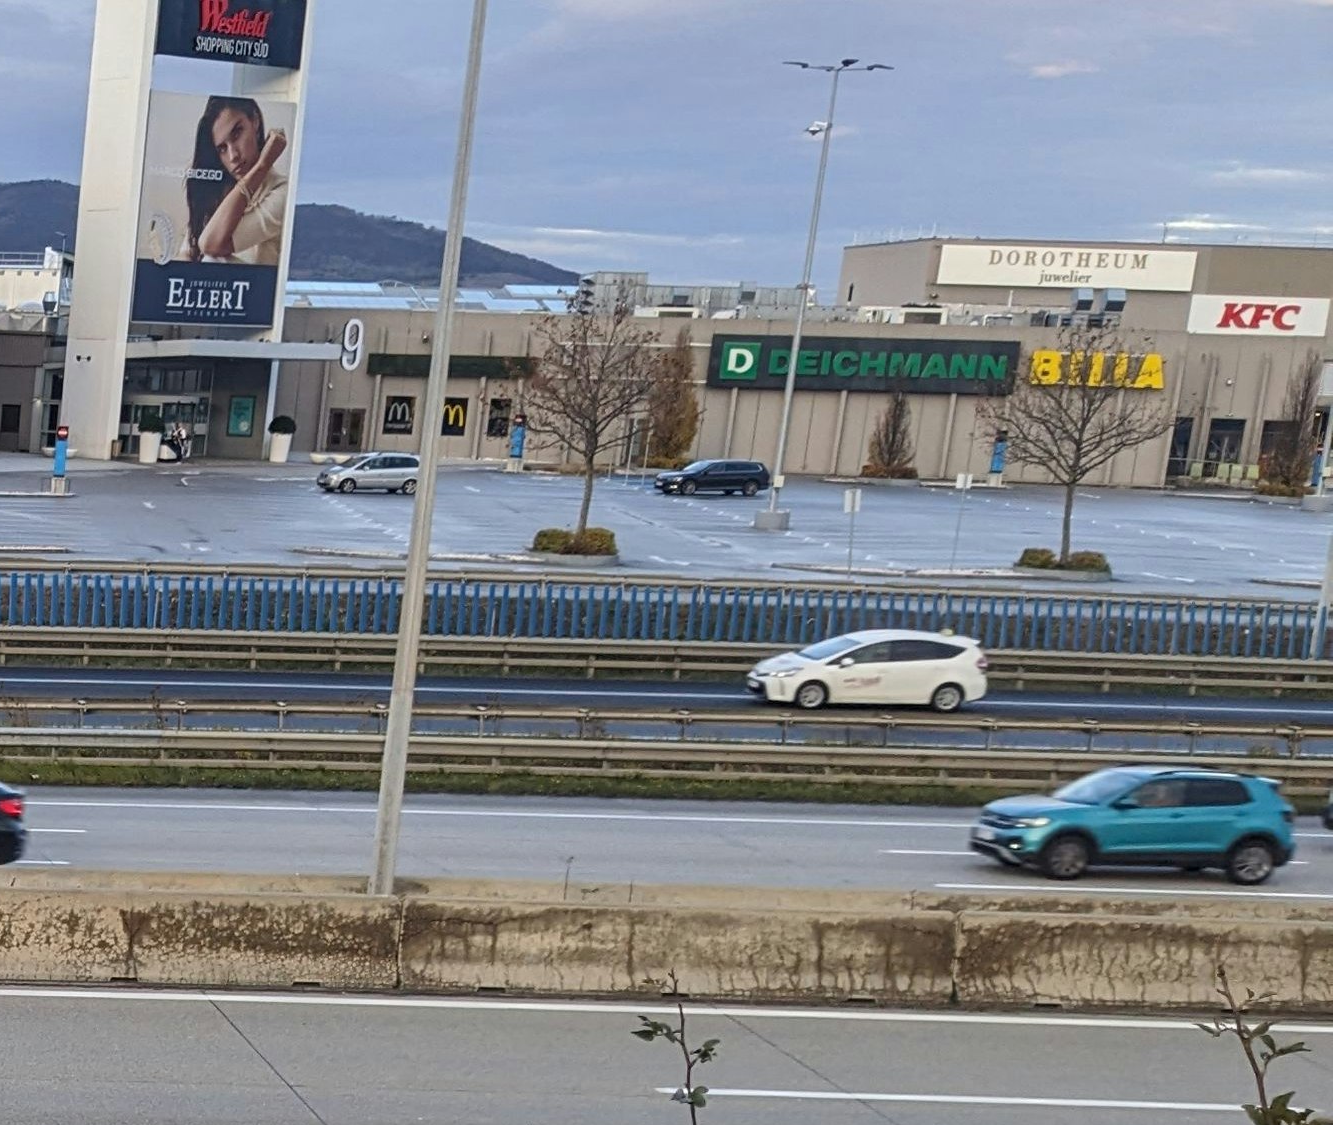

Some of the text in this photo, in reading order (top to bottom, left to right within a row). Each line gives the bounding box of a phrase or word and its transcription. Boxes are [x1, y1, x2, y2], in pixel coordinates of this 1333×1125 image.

[199, 0, 272, 38] Westfield
[195, 35, 269, 58] SHOPPING CITY SÜD
[988, 248, 1150, 271] DOROTHEUM
[1038, 269, 1093, 285] juwelier
[166, 277, 250, 310] ELLERT
[1217, 302, 1301, 331] KFC
[341, 318, 364, 371] 9
[769, 349, 1009, 380] DEICHMANN
